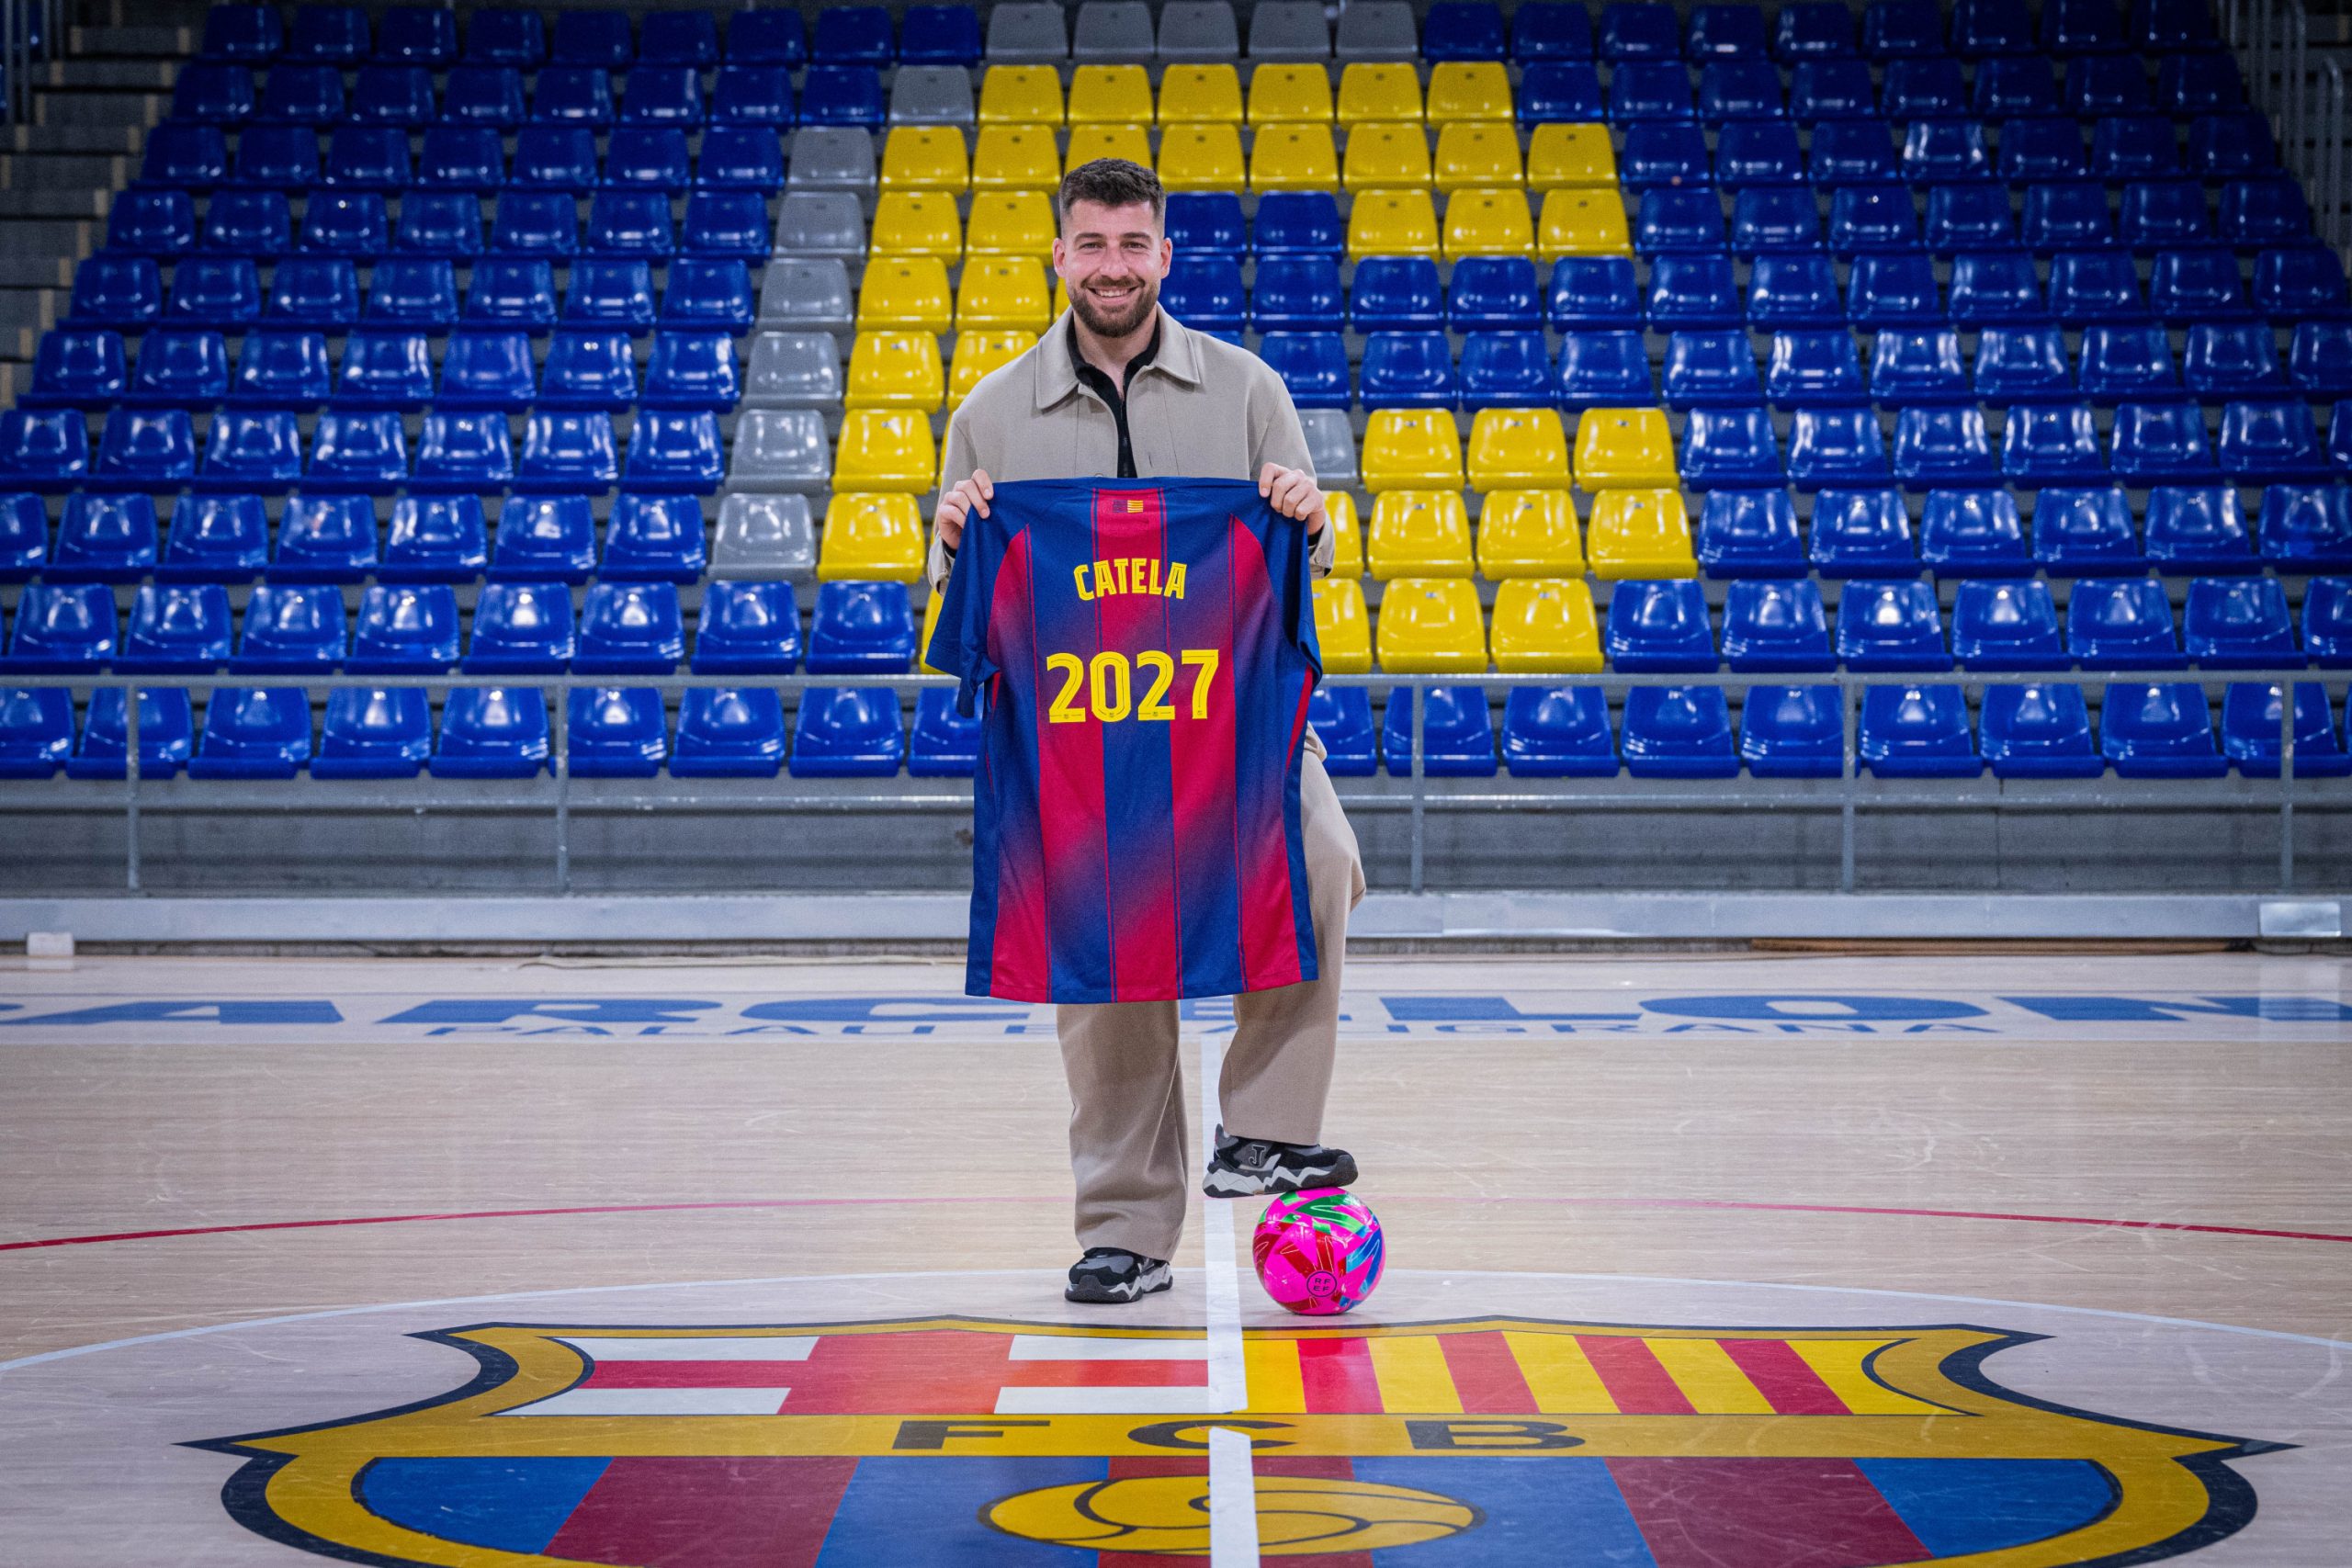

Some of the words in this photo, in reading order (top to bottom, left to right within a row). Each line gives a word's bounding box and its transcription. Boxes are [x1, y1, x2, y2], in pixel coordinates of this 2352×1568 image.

[1074, 558, 1187, 601] CATELA
[1046, 649, 1219, 724] 2027
[423, 1025, 936, 1036] PALAU
